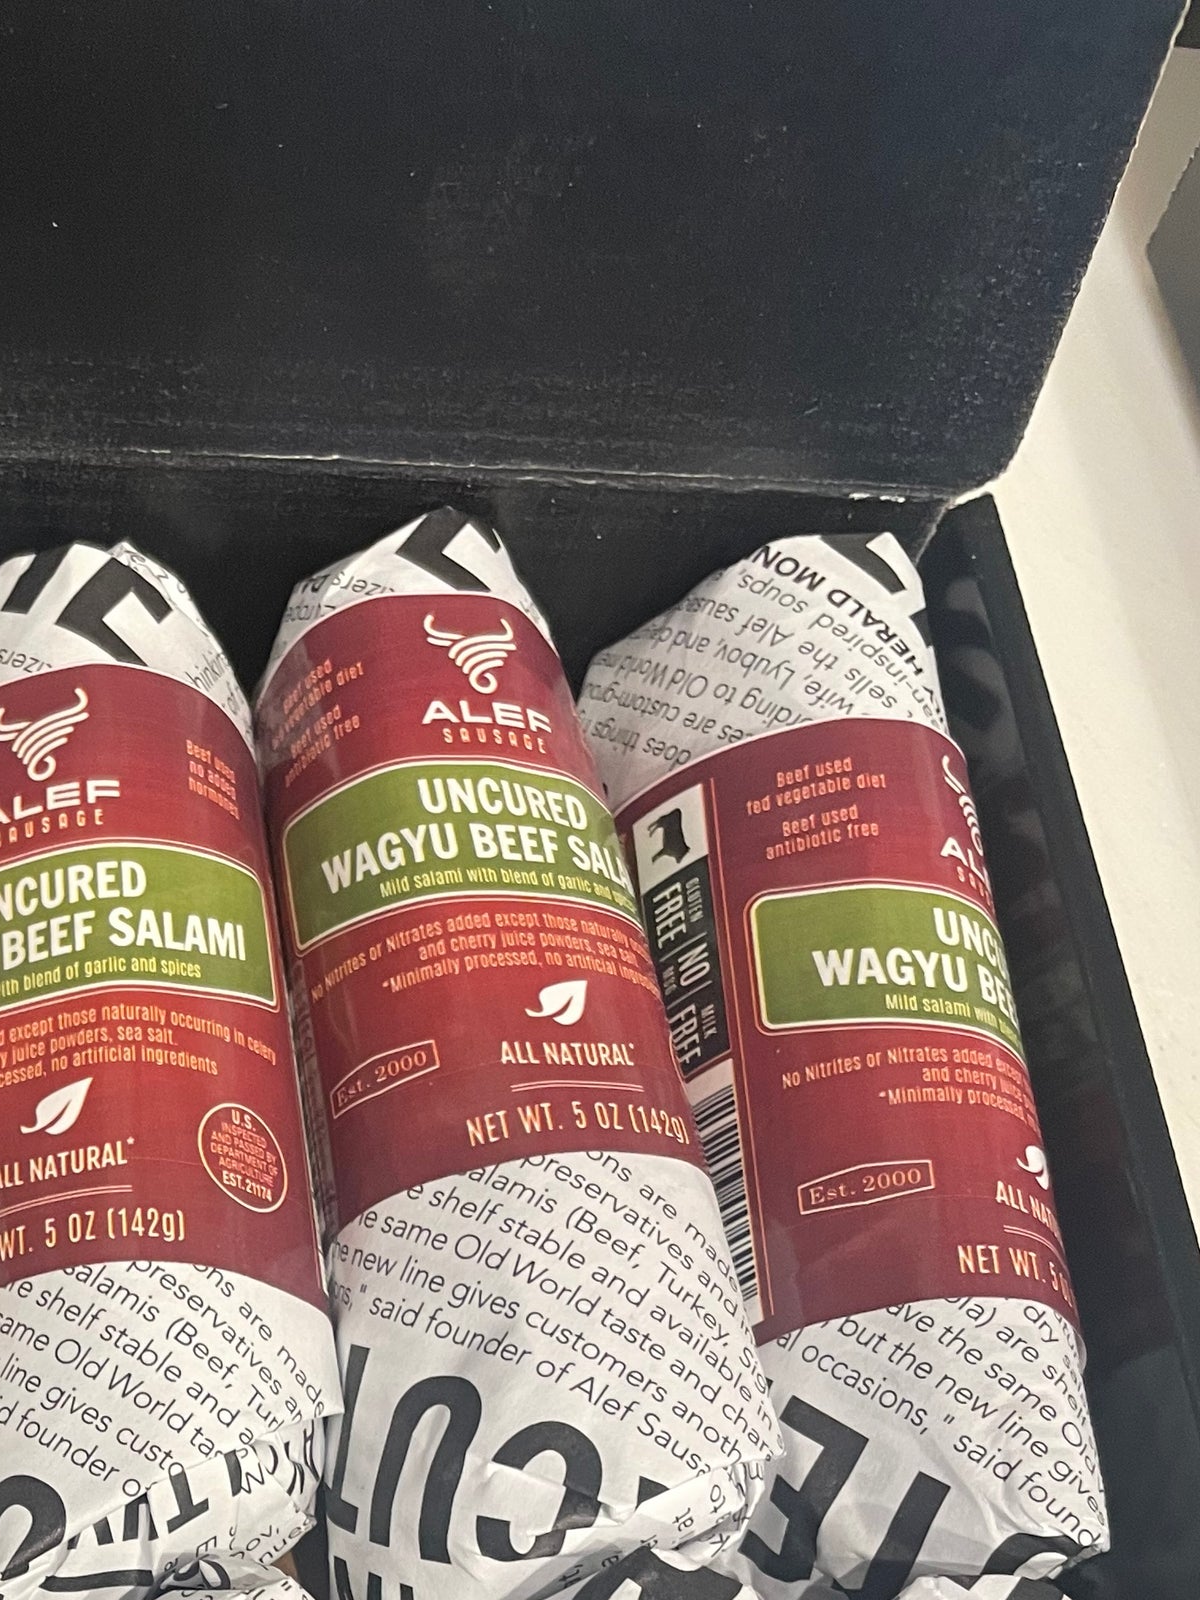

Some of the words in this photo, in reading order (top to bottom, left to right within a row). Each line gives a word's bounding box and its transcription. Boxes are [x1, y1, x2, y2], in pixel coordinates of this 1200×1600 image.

[746, 798, 772, 816] fed
[775, 775, 852, 807] vegetable
[857, 772, 887, 790] diet
[776, 767, 810, 788] Beef
[815, 757, 852, 778] used
[417, 778, 588, 830] UNCURED
[321, 822, 459, 894] WAGYU
[469, 823, 558, 864] BEEF
[766, 828, 842, 861] antibiotic
[846, 822, 880, 840] free
[379, 881, 410, 899] Mild
[414, 868, 463, 888] salami
[466, 868, 498, 882] with
[501, 869, 537, 886] blend
[541, 872, 555, 888] of
[558, 874, 592, 894] garlic
[1, 911, 96, 971] BEEF
[108, 907, 246, 961] SALAMI
[446, 912, 491, 932] added
[495, 912, 540, 930] except
[543, 912, 578, 932] those
[652, 882, 687, 950] FREE
[677, 943, 712, 987] NO
[812, 947, 969, 993] WAGYU
[51, 1025, 114, 1055] powders,
[117, 1027, 144, 1042] sea
[668, 1003, 701, 1073] FREE
[374, 1050, 428, 1083] 2000
[805, 1058, 861, 1082] Nitrites
[866, 1054, 881, 1068] or
[888, 1047, 948, 1065] Nitrates
[953, 1051, 993, 1067] added
[809, 1184, 857, 1206] Est.
[861, 1167, 922, 1193] 2000
[45, 1219, 56, 1248] 5
[68, 1210, 96, 1243] OZ
[107, 1207, 185, 1242] (142g)
[99, 1320, 183, 1383] stable
[185, 1376, 241, 1428] and
[427, 1308, 532, 1367] founder
[535, 1358, 575, 1389] of
[569, 1376, 639, 1424] Alef
[525, 1310, 670, 1404] customers
[600, 1307, 667, 1363] taste
[667, 1359, 722, 1402] and
[54, 1338, 112, 1381] Old
[107, 1364, 189, 1434] World
[837, 1316, 888, 1354] but
[887, 1339, 934, 1379] the
[935, 1373, 998, 1419] new
[997, 1411, 1050, 1458] line
[15, 1409, 120, 1481] founder
